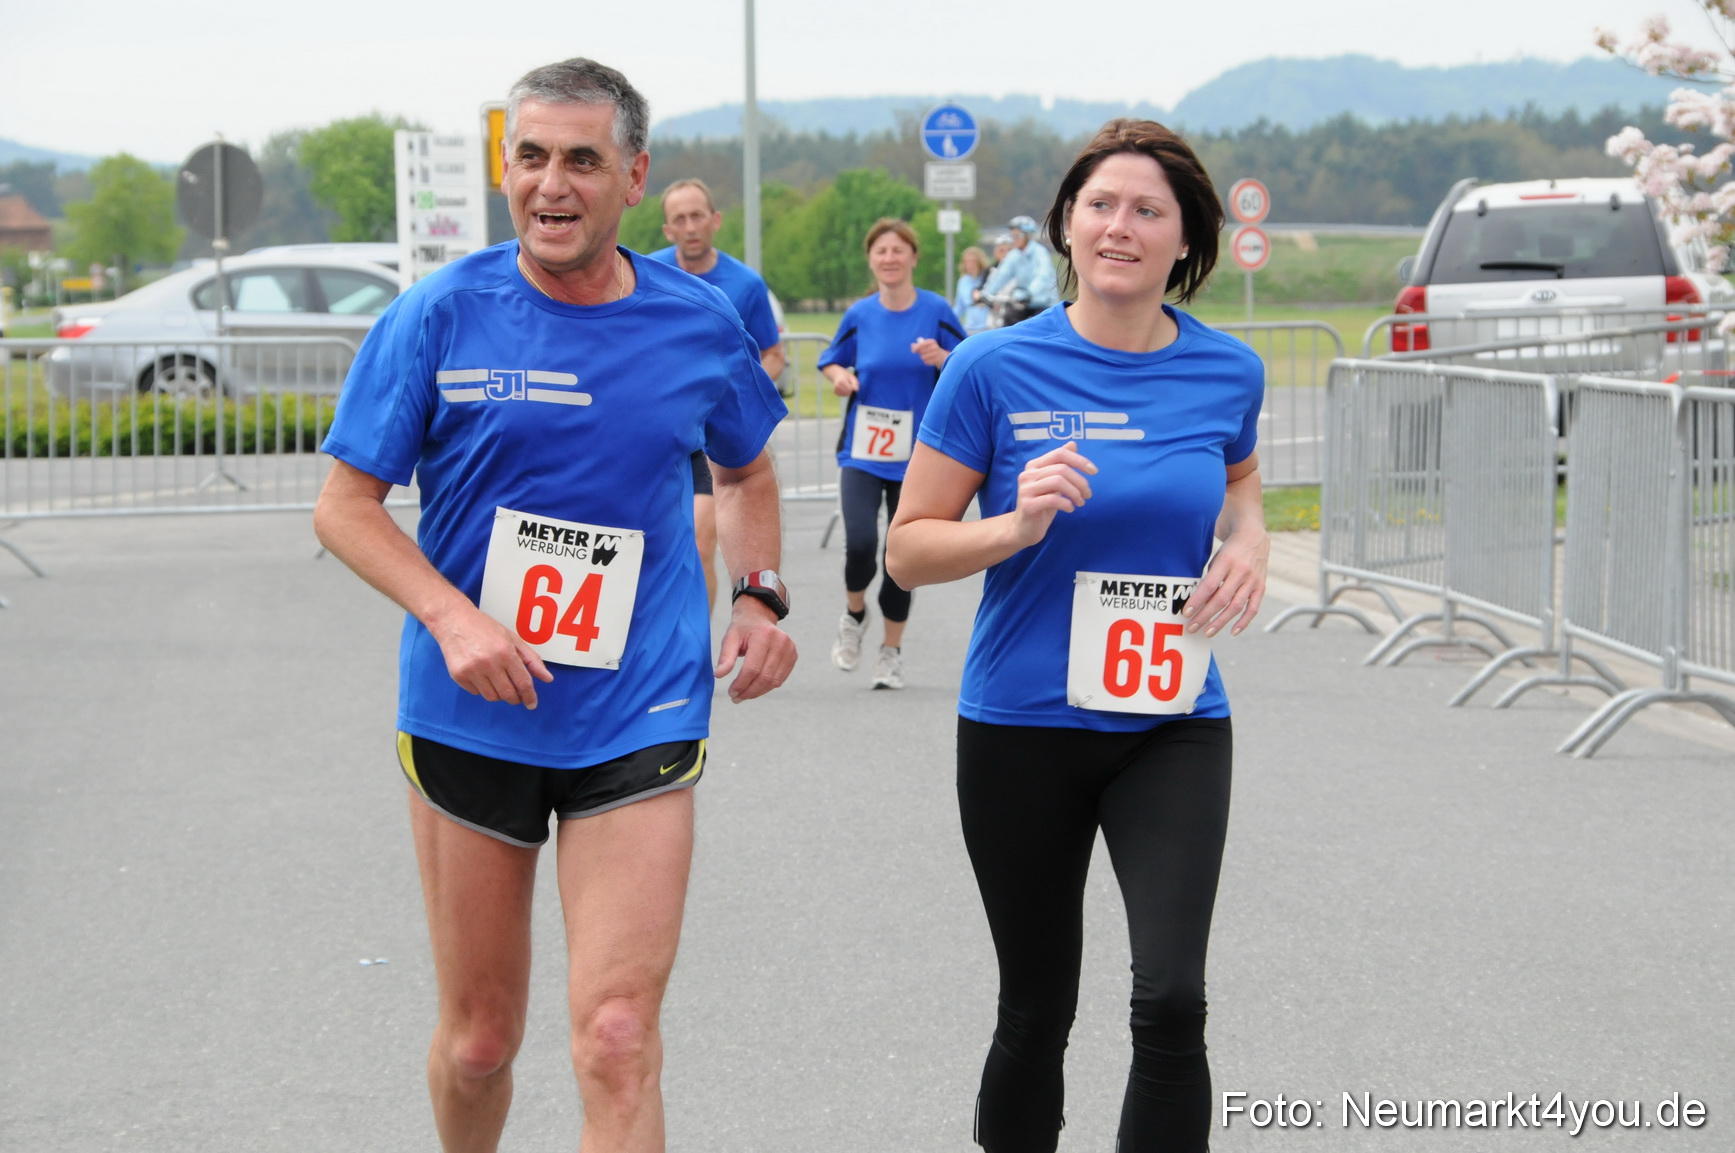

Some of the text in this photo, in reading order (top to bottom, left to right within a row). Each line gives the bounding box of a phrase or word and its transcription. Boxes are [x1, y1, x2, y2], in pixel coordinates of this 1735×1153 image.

[1240, 191, 1261, 211] 60
[867, 425, 895, 457] 72
[517, 520, 590, 548] MEYER
[517, 536, 588, 560] WERBUNG
[1100, 580, 1168, 598] MEYER
[515, 564, 604, 652] 64
[1100, 597, 1168, 611] WERBUNG
[1102, 618, 1184, 702] 65
